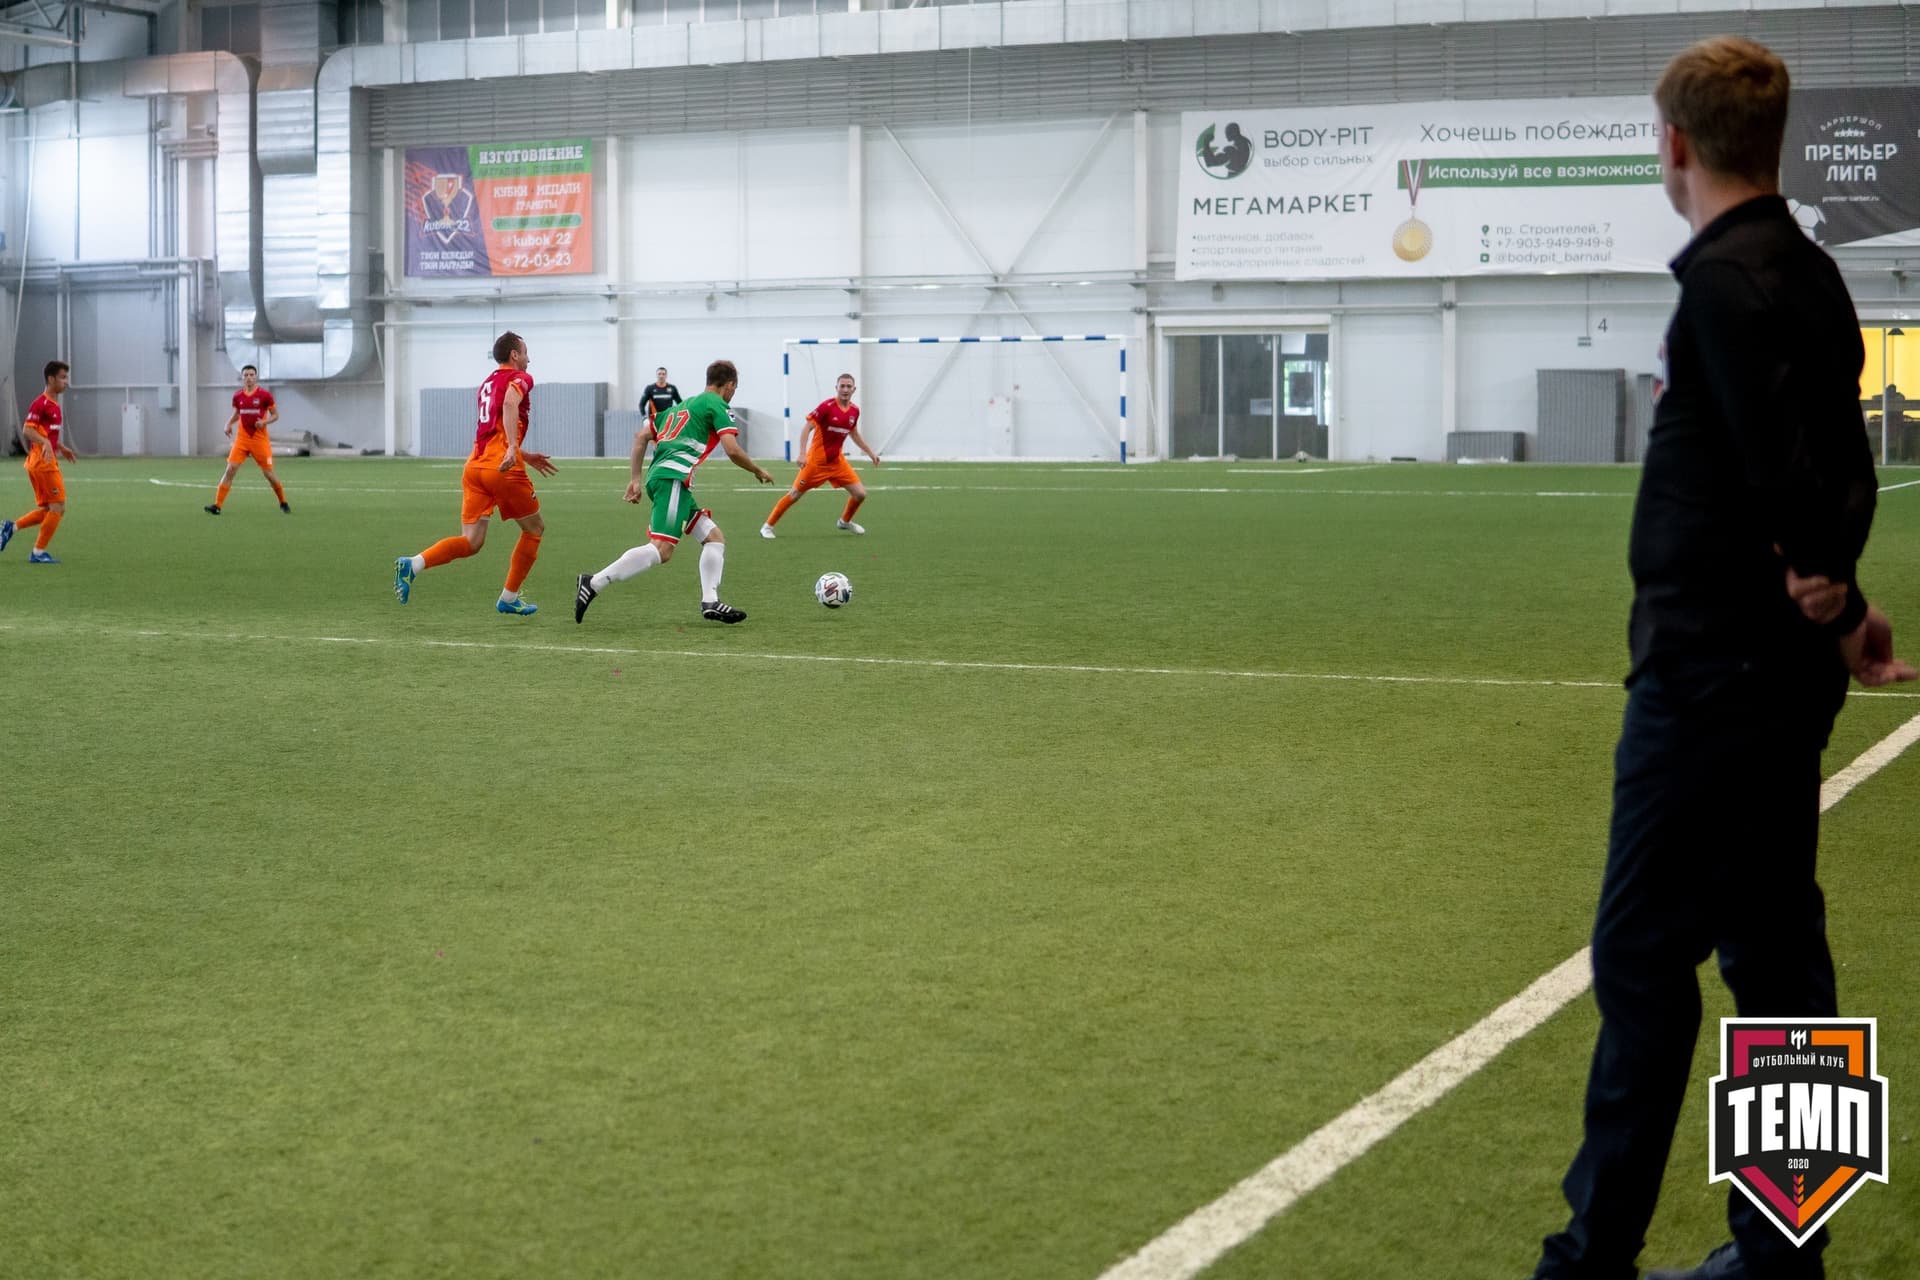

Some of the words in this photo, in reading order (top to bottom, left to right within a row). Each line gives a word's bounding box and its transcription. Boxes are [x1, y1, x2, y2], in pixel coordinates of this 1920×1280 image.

[1264, 126, 1374, 149] BODY-PIT
[1420, 124, 1517, 142] Хочешь
[479, 145, 583, 164] ИЗГОТОВЛЕНИЕ
[1805, 143, 1898, 161] ПРЕМЬЕР
[1263, 155, 1309, 169] выбор
[1313, 154, 1374, 167] сильных
[1428, 164, 1518, 183] Используй
[1523, 167, 1552, 179] все
[1826, 165, 1878, 182] ЛИГА
[494, 184, 528, 198] КУБКИ
[536, 182, 581, 195] МЕДАЛИ
[1193, 194, 1373, 215] МЕГАМАРКЕТ
[514, 252, 571, 268] 72-03-23
[1597, 318, 1609, 333] 4
[480, 381, 493, 423] 5
[657, 409, 690, 442] 17
